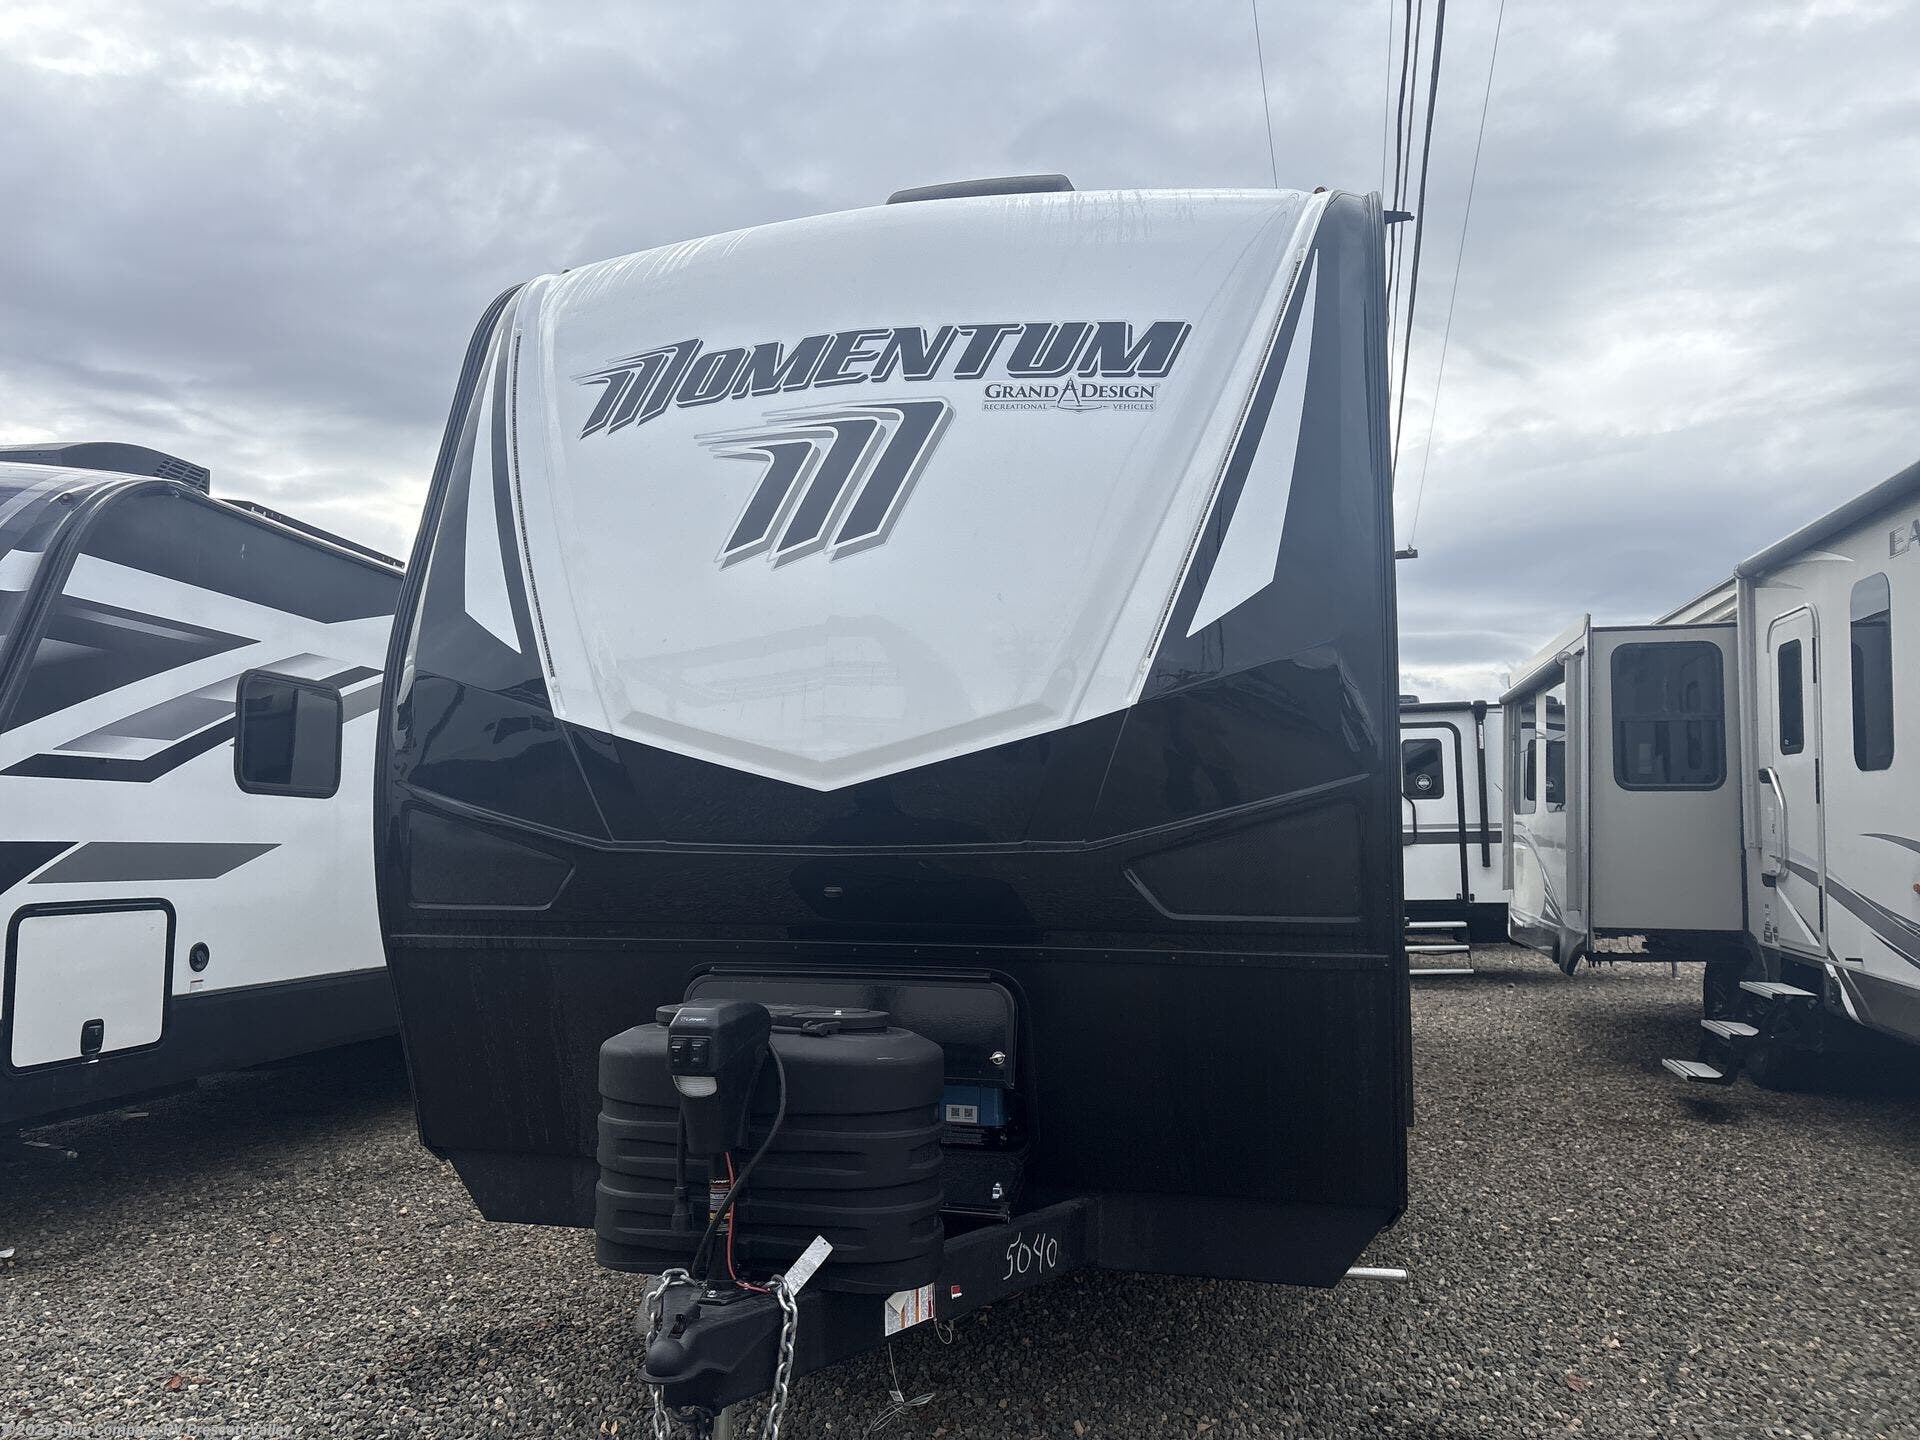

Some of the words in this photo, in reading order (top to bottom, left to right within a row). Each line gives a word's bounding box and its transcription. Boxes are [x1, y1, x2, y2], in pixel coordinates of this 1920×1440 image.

[984, 383, 1059, 399] GRAND
[1081, 383, 1155, 399] DESIGN
[1003, 1231, 1058, 1280] 5040
